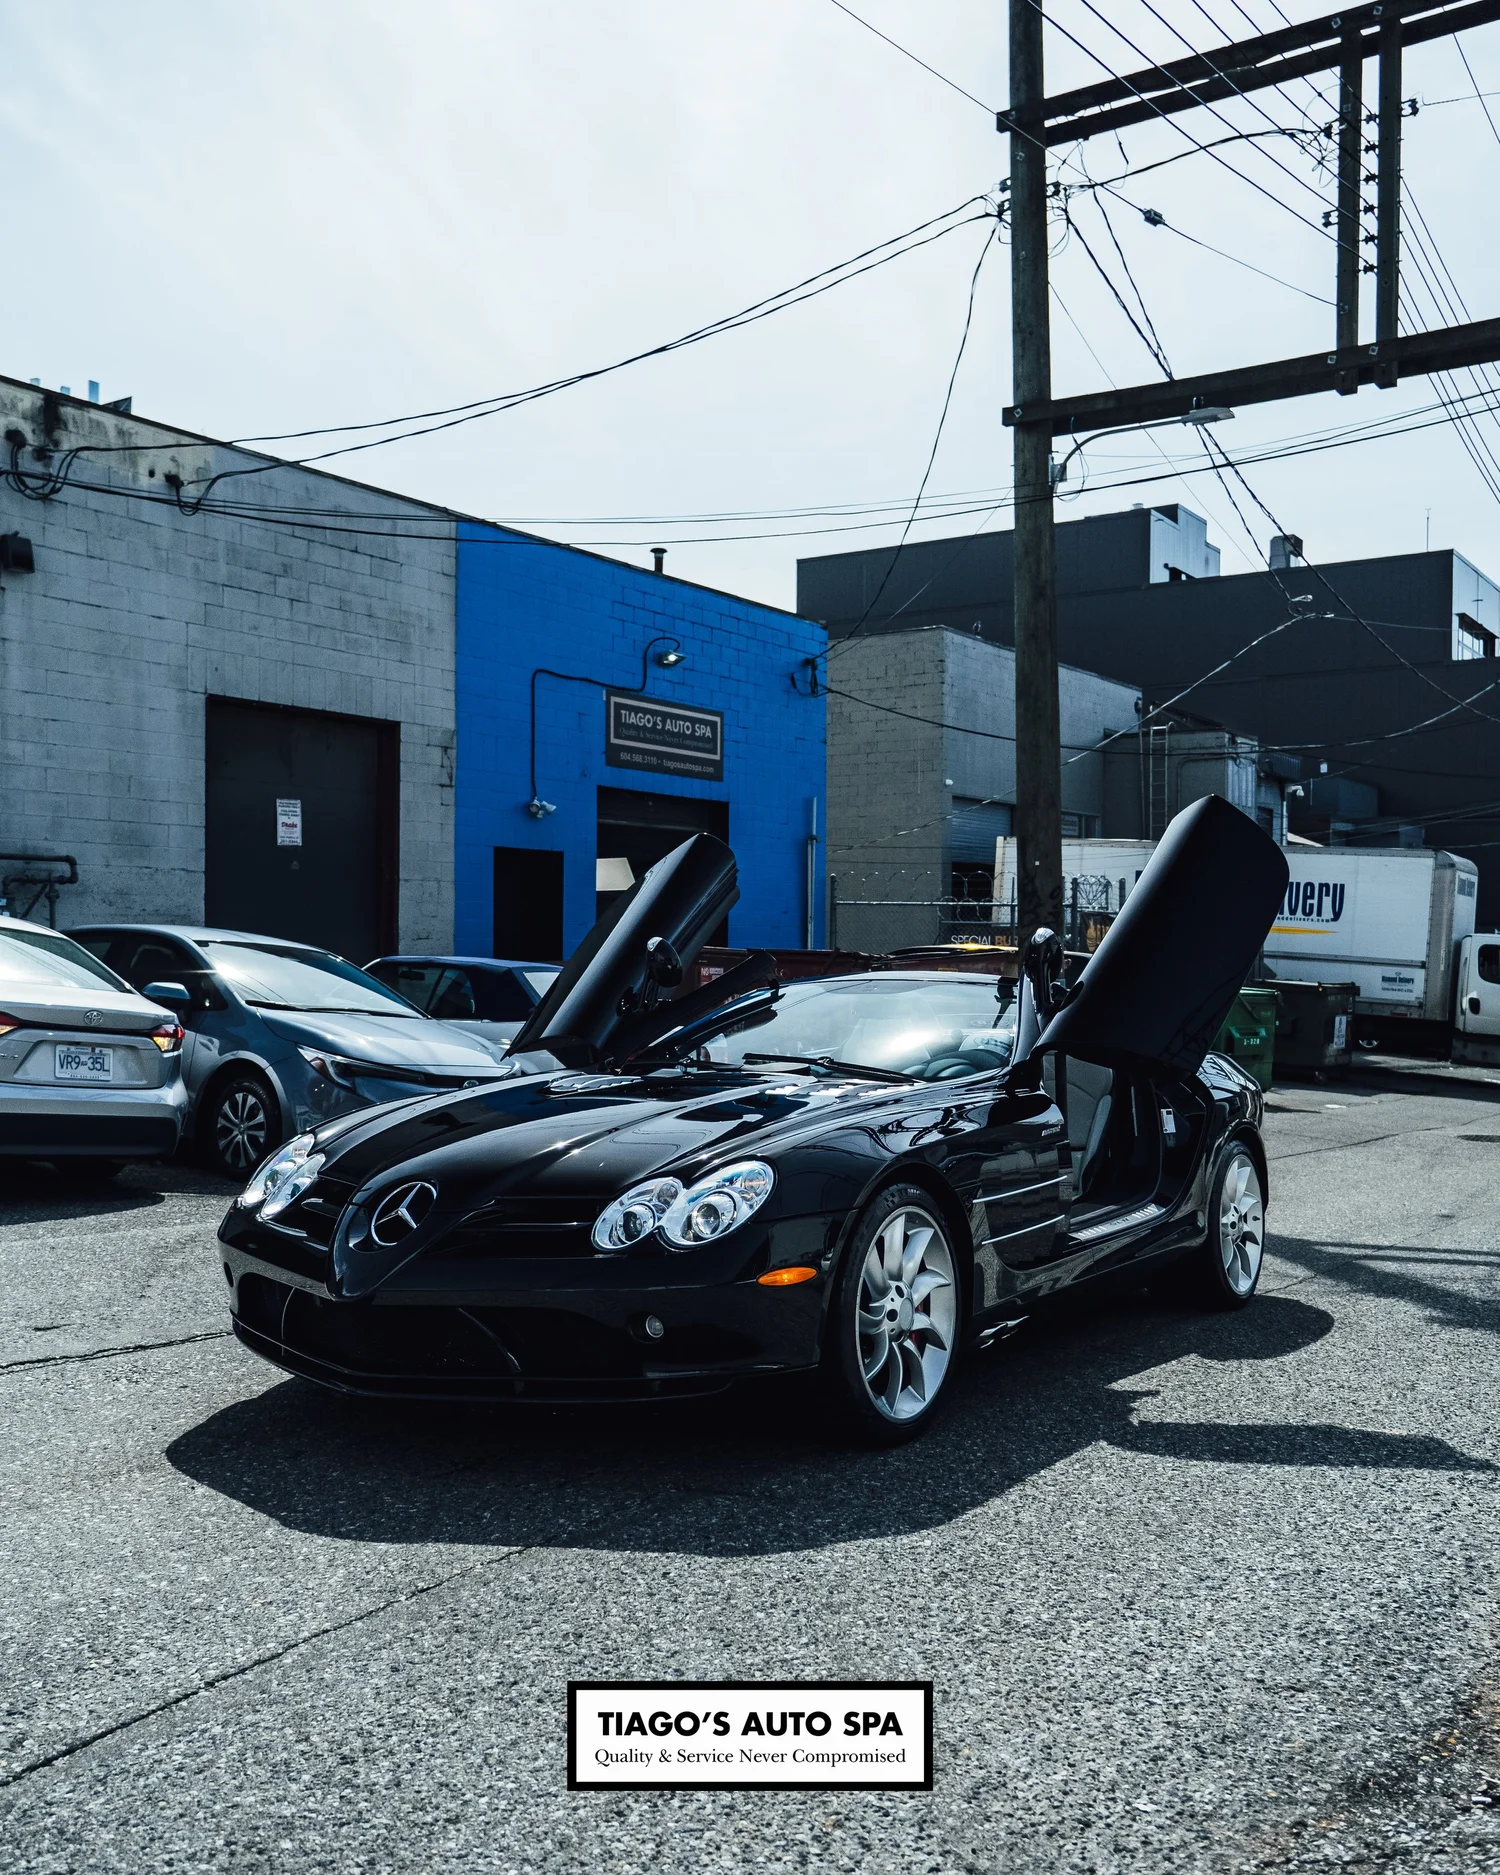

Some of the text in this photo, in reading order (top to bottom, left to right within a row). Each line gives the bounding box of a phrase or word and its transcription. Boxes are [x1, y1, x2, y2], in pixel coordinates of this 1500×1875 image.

[620, 710, 712, 738] TIAGO'S AUTO SPA
[620, 752, 714, 773] 604.568.3110 tiagosautospa.com
[1279, 881, 1345, 922] very
[58, 1053, 81, 1070] VR9
[88, 1056, 110, 1072] 35L
